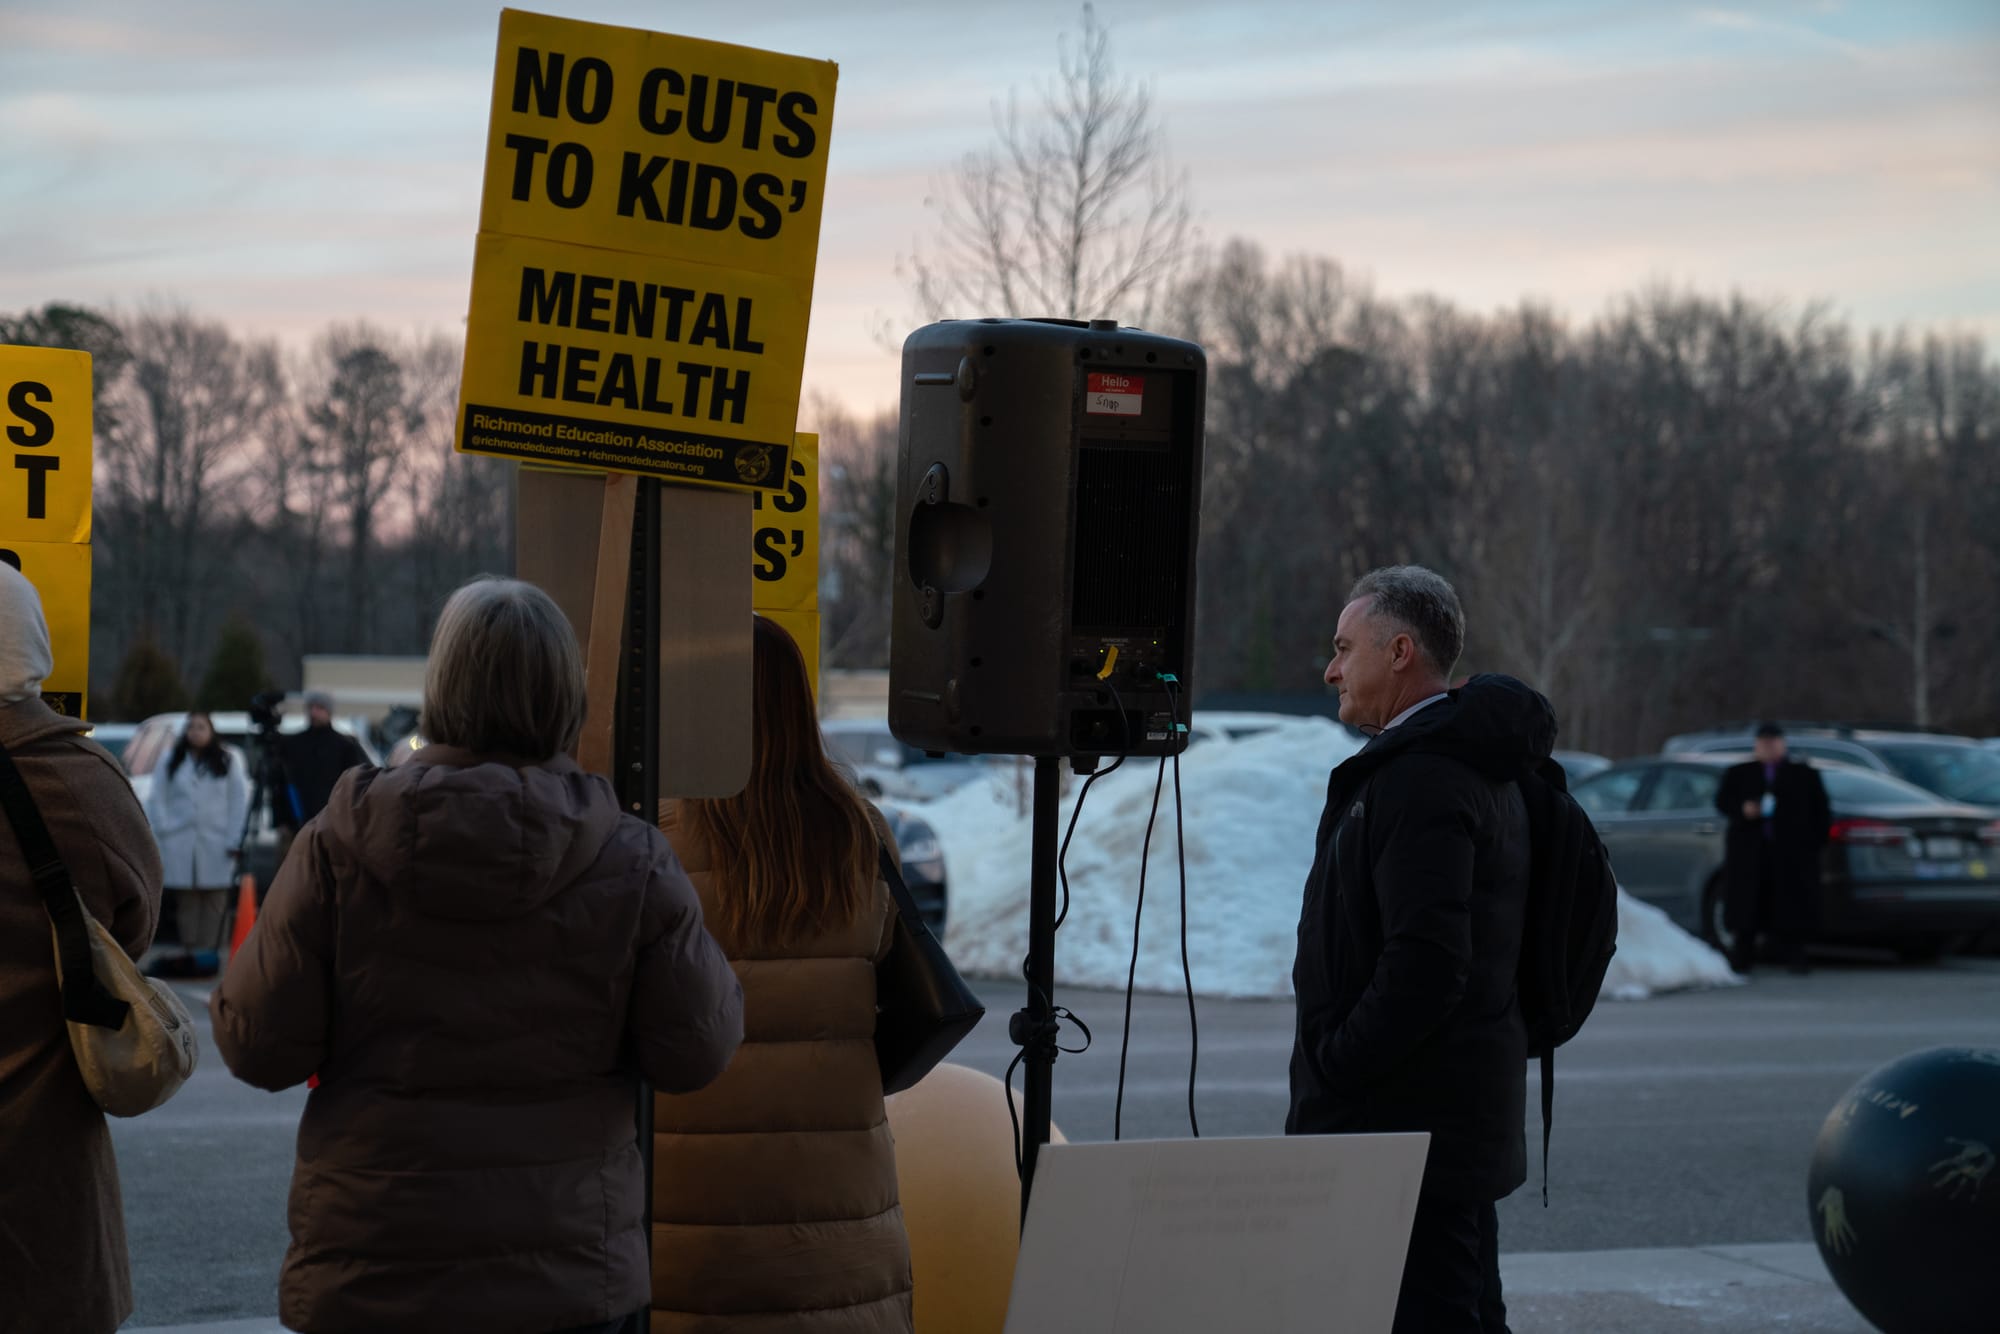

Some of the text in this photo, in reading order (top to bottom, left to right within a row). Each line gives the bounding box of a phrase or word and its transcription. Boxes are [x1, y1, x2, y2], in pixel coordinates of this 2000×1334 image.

[512, 47, 817, 158] NO CUTS
[506, 134, 807, 239] TO KIDS'
[518, 267, 764, 354] MENTAL
[519, 341, 750, 424] HEALTH
[1102, 375, 1130, 388] Hello
[472, 435, 704, 475] @richmondeducators richmondeducators.org
[473, 414, 723, 459] Richmond Education Association
